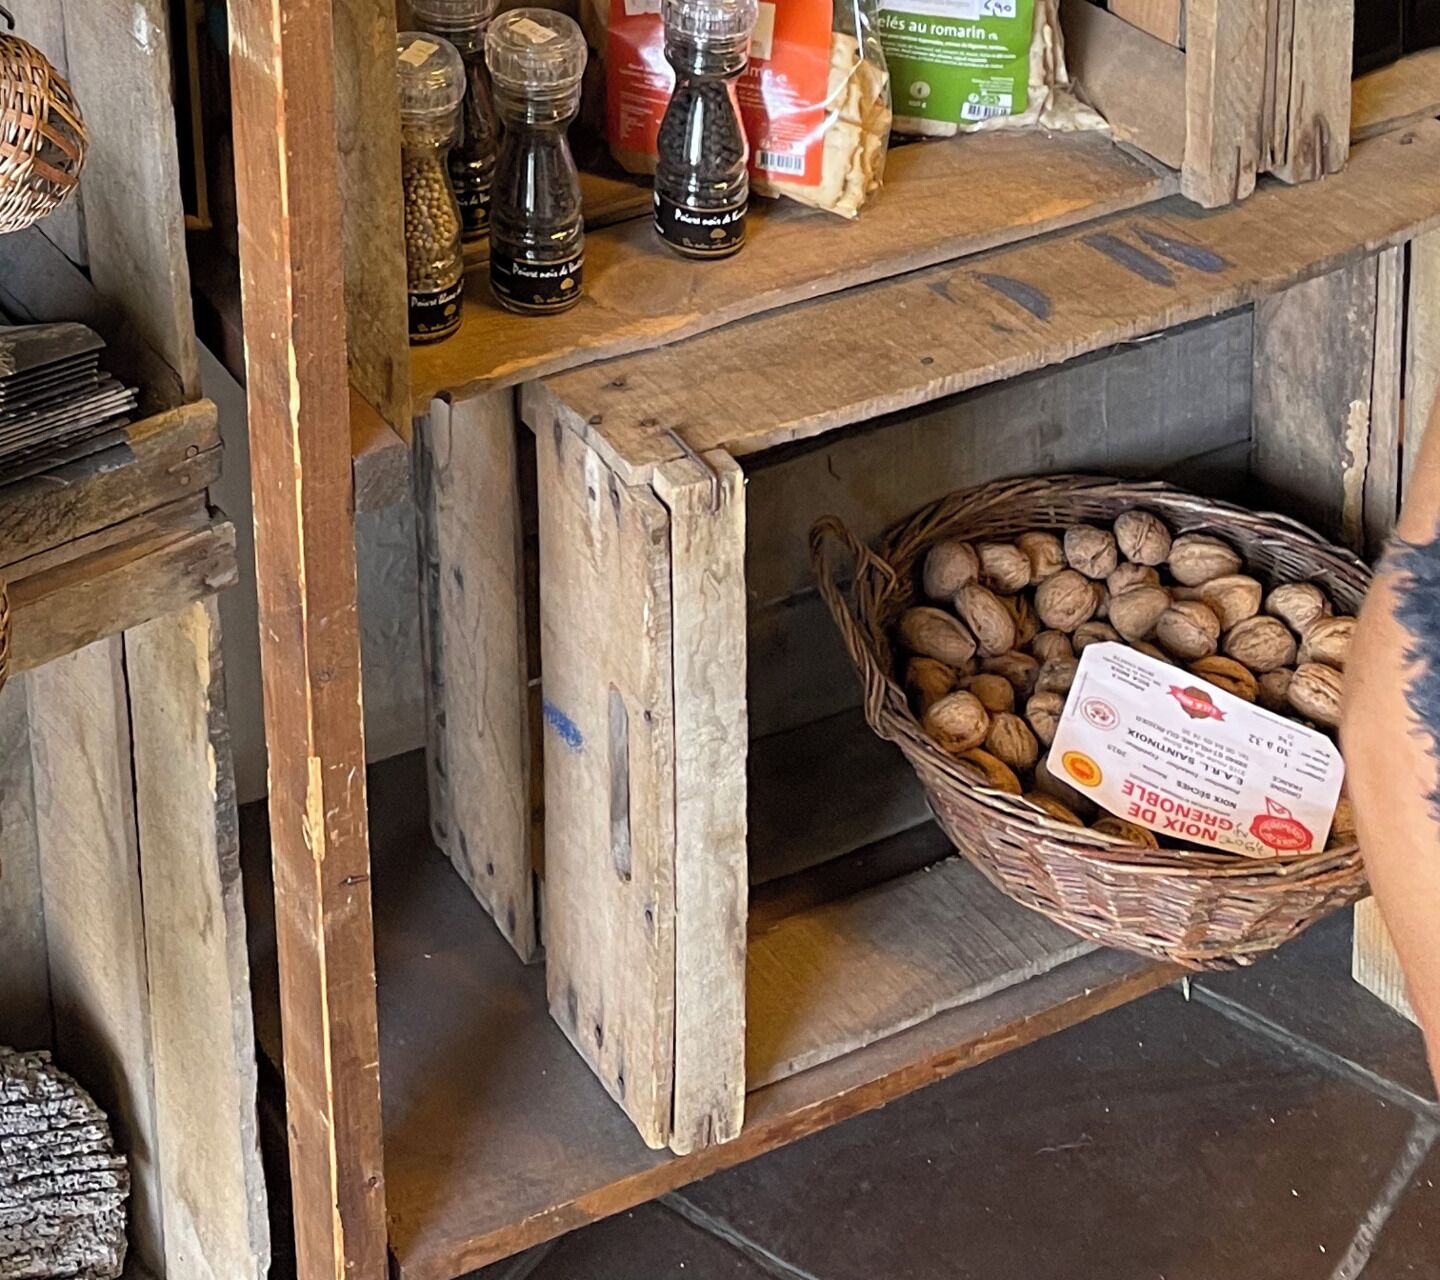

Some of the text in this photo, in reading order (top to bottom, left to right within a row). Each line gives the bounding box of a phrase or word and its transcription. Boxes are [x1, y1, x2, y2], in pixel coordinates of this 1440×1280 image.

[908, 21, 927, 33] au
[930, 23, 986, 40] romarin
[1126, 727, 1196, 766] SAINTINOIX
[1247, 731, 1264, 745] 32
[1276, 743, 1291, 757] 30
[1121, 778, 1234, 831] GRENOBLE
[1212, 794, 1238, 810] NOIX
[1127, 801, 1157, 825] DE
[1168, 817, 1219, 842] NOIX
